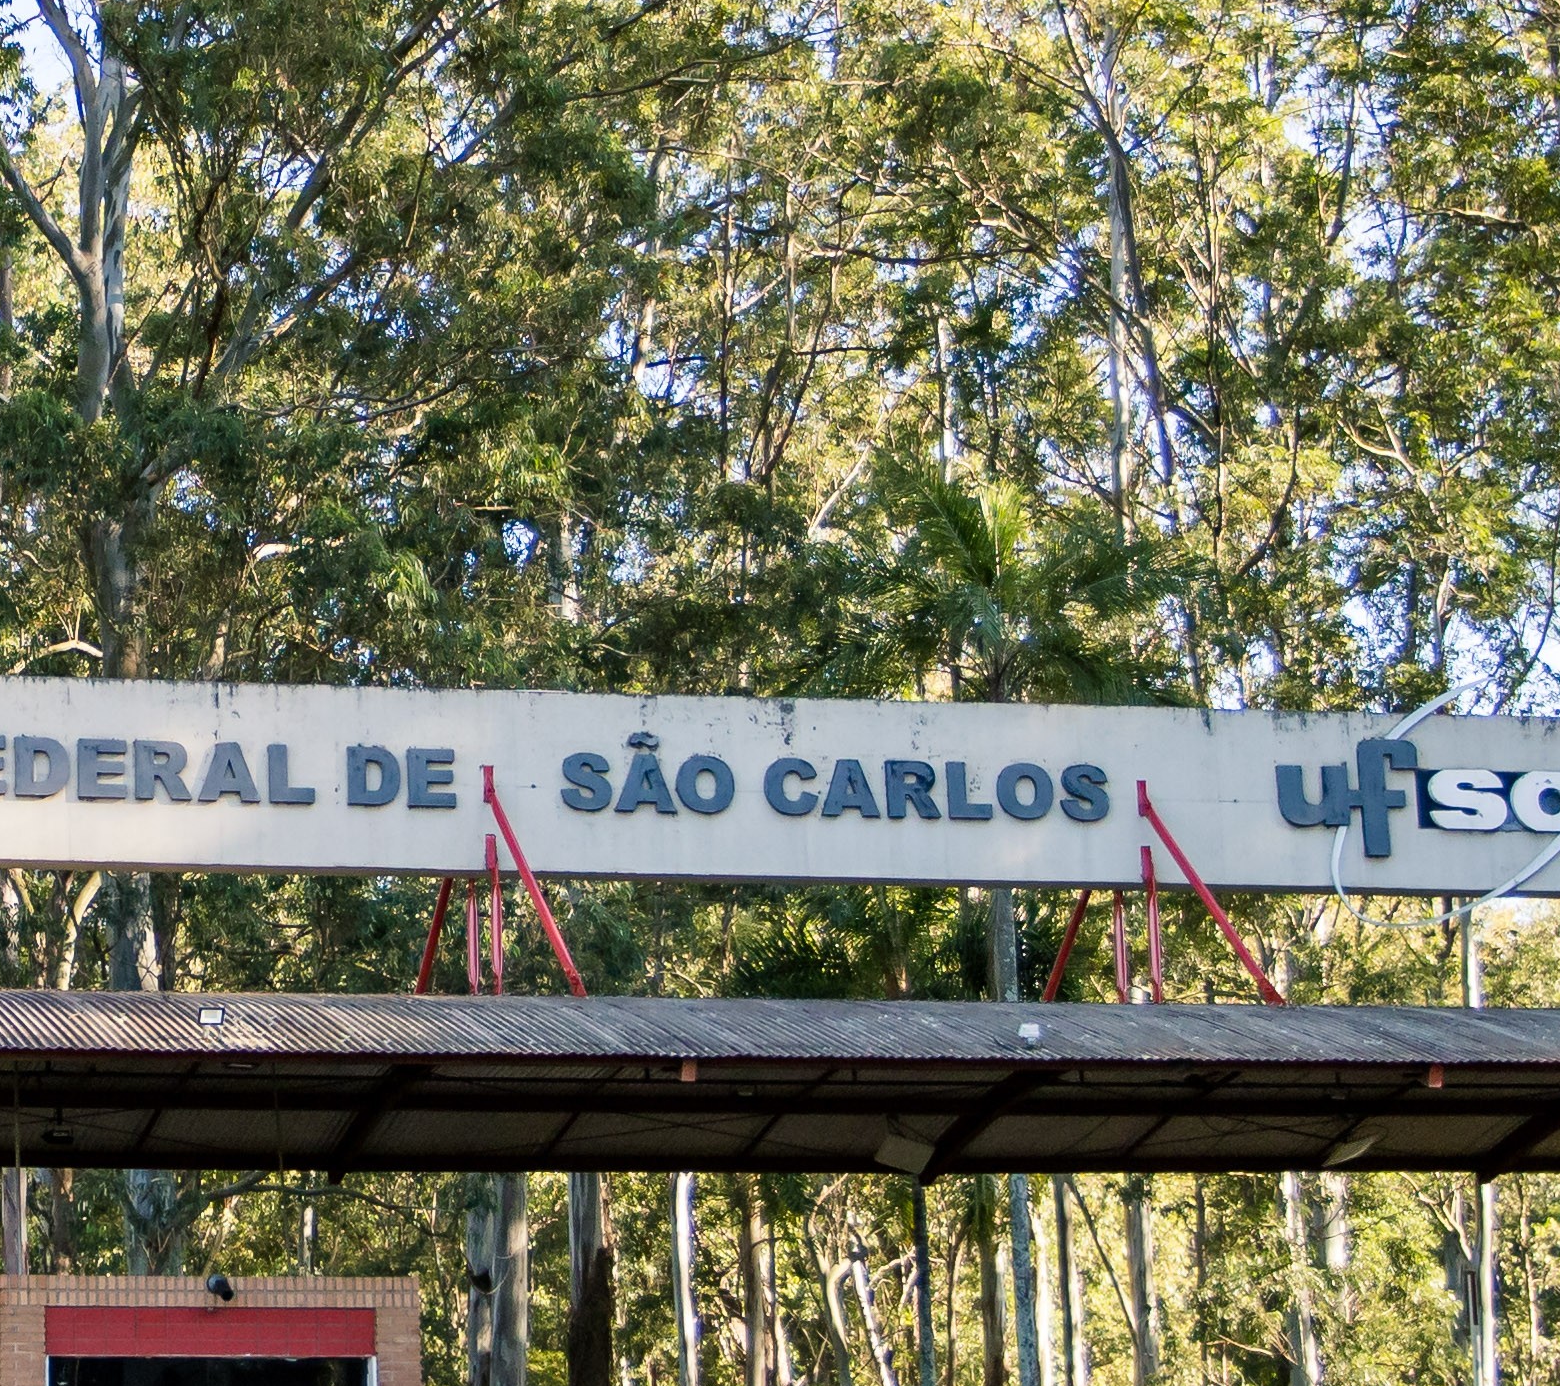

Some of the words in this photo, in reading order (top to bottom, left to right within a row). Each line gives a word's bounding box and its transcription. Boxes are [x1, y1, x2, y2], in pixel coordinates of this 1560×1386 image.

[346, 744, 458, 809] DE
[560, 731, 736, 815] SÃO
[763, 757, 1111, 822] CARLOS
